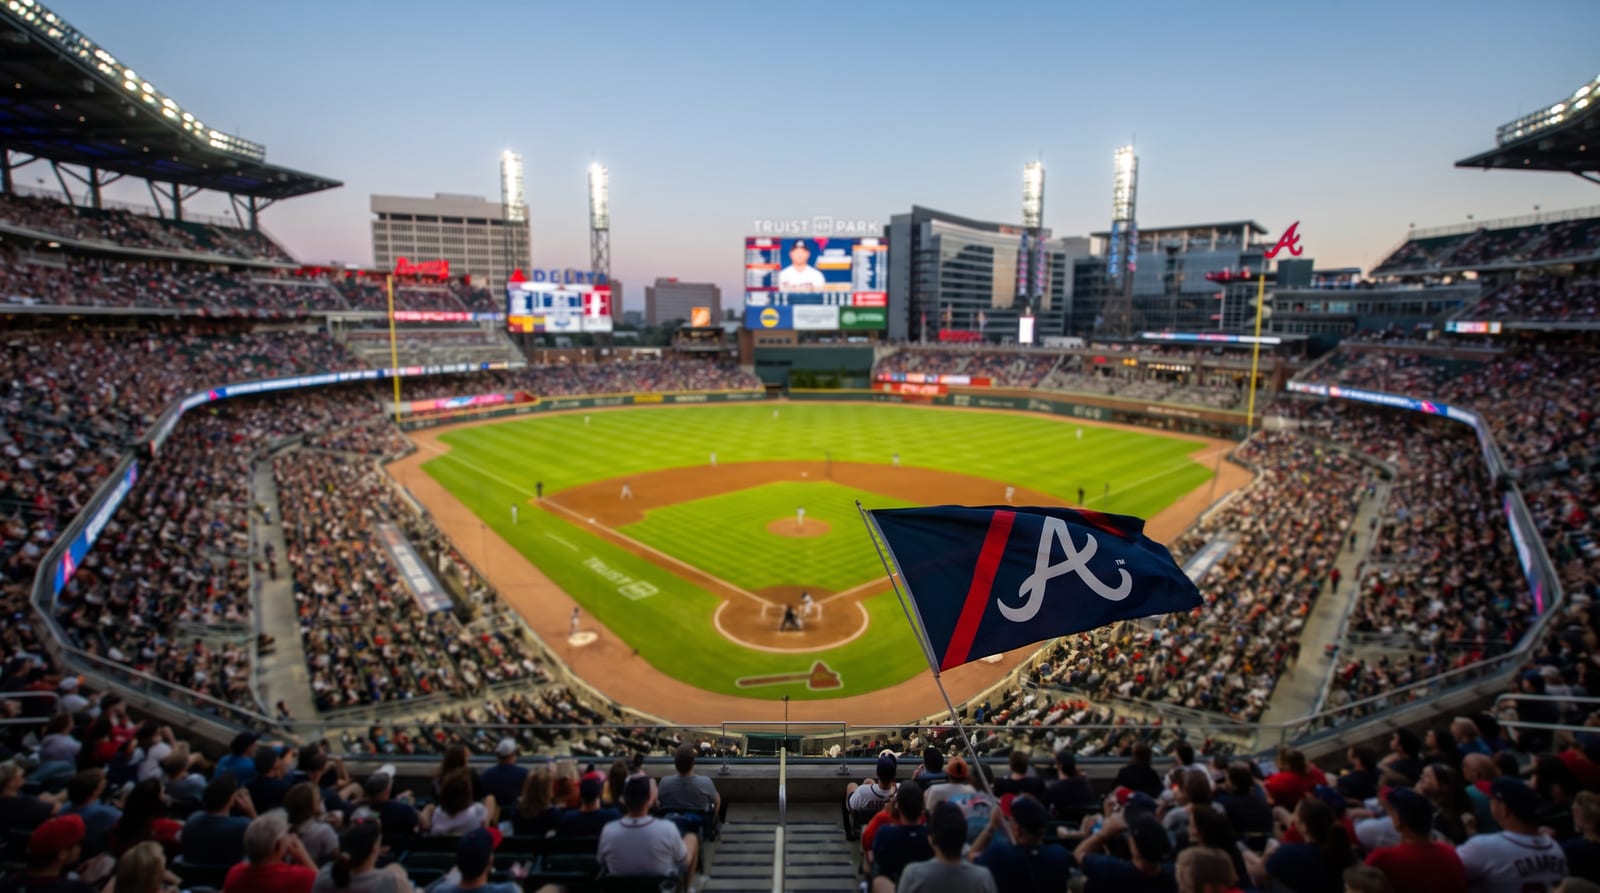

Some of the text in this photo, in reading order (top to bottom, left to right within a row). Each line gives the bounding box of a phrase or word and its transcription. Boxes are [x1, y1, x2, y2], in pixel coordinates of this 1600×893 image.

[753, 219, 880, 233] TRUIST PARK
[997, 516, 1133, 623] A
